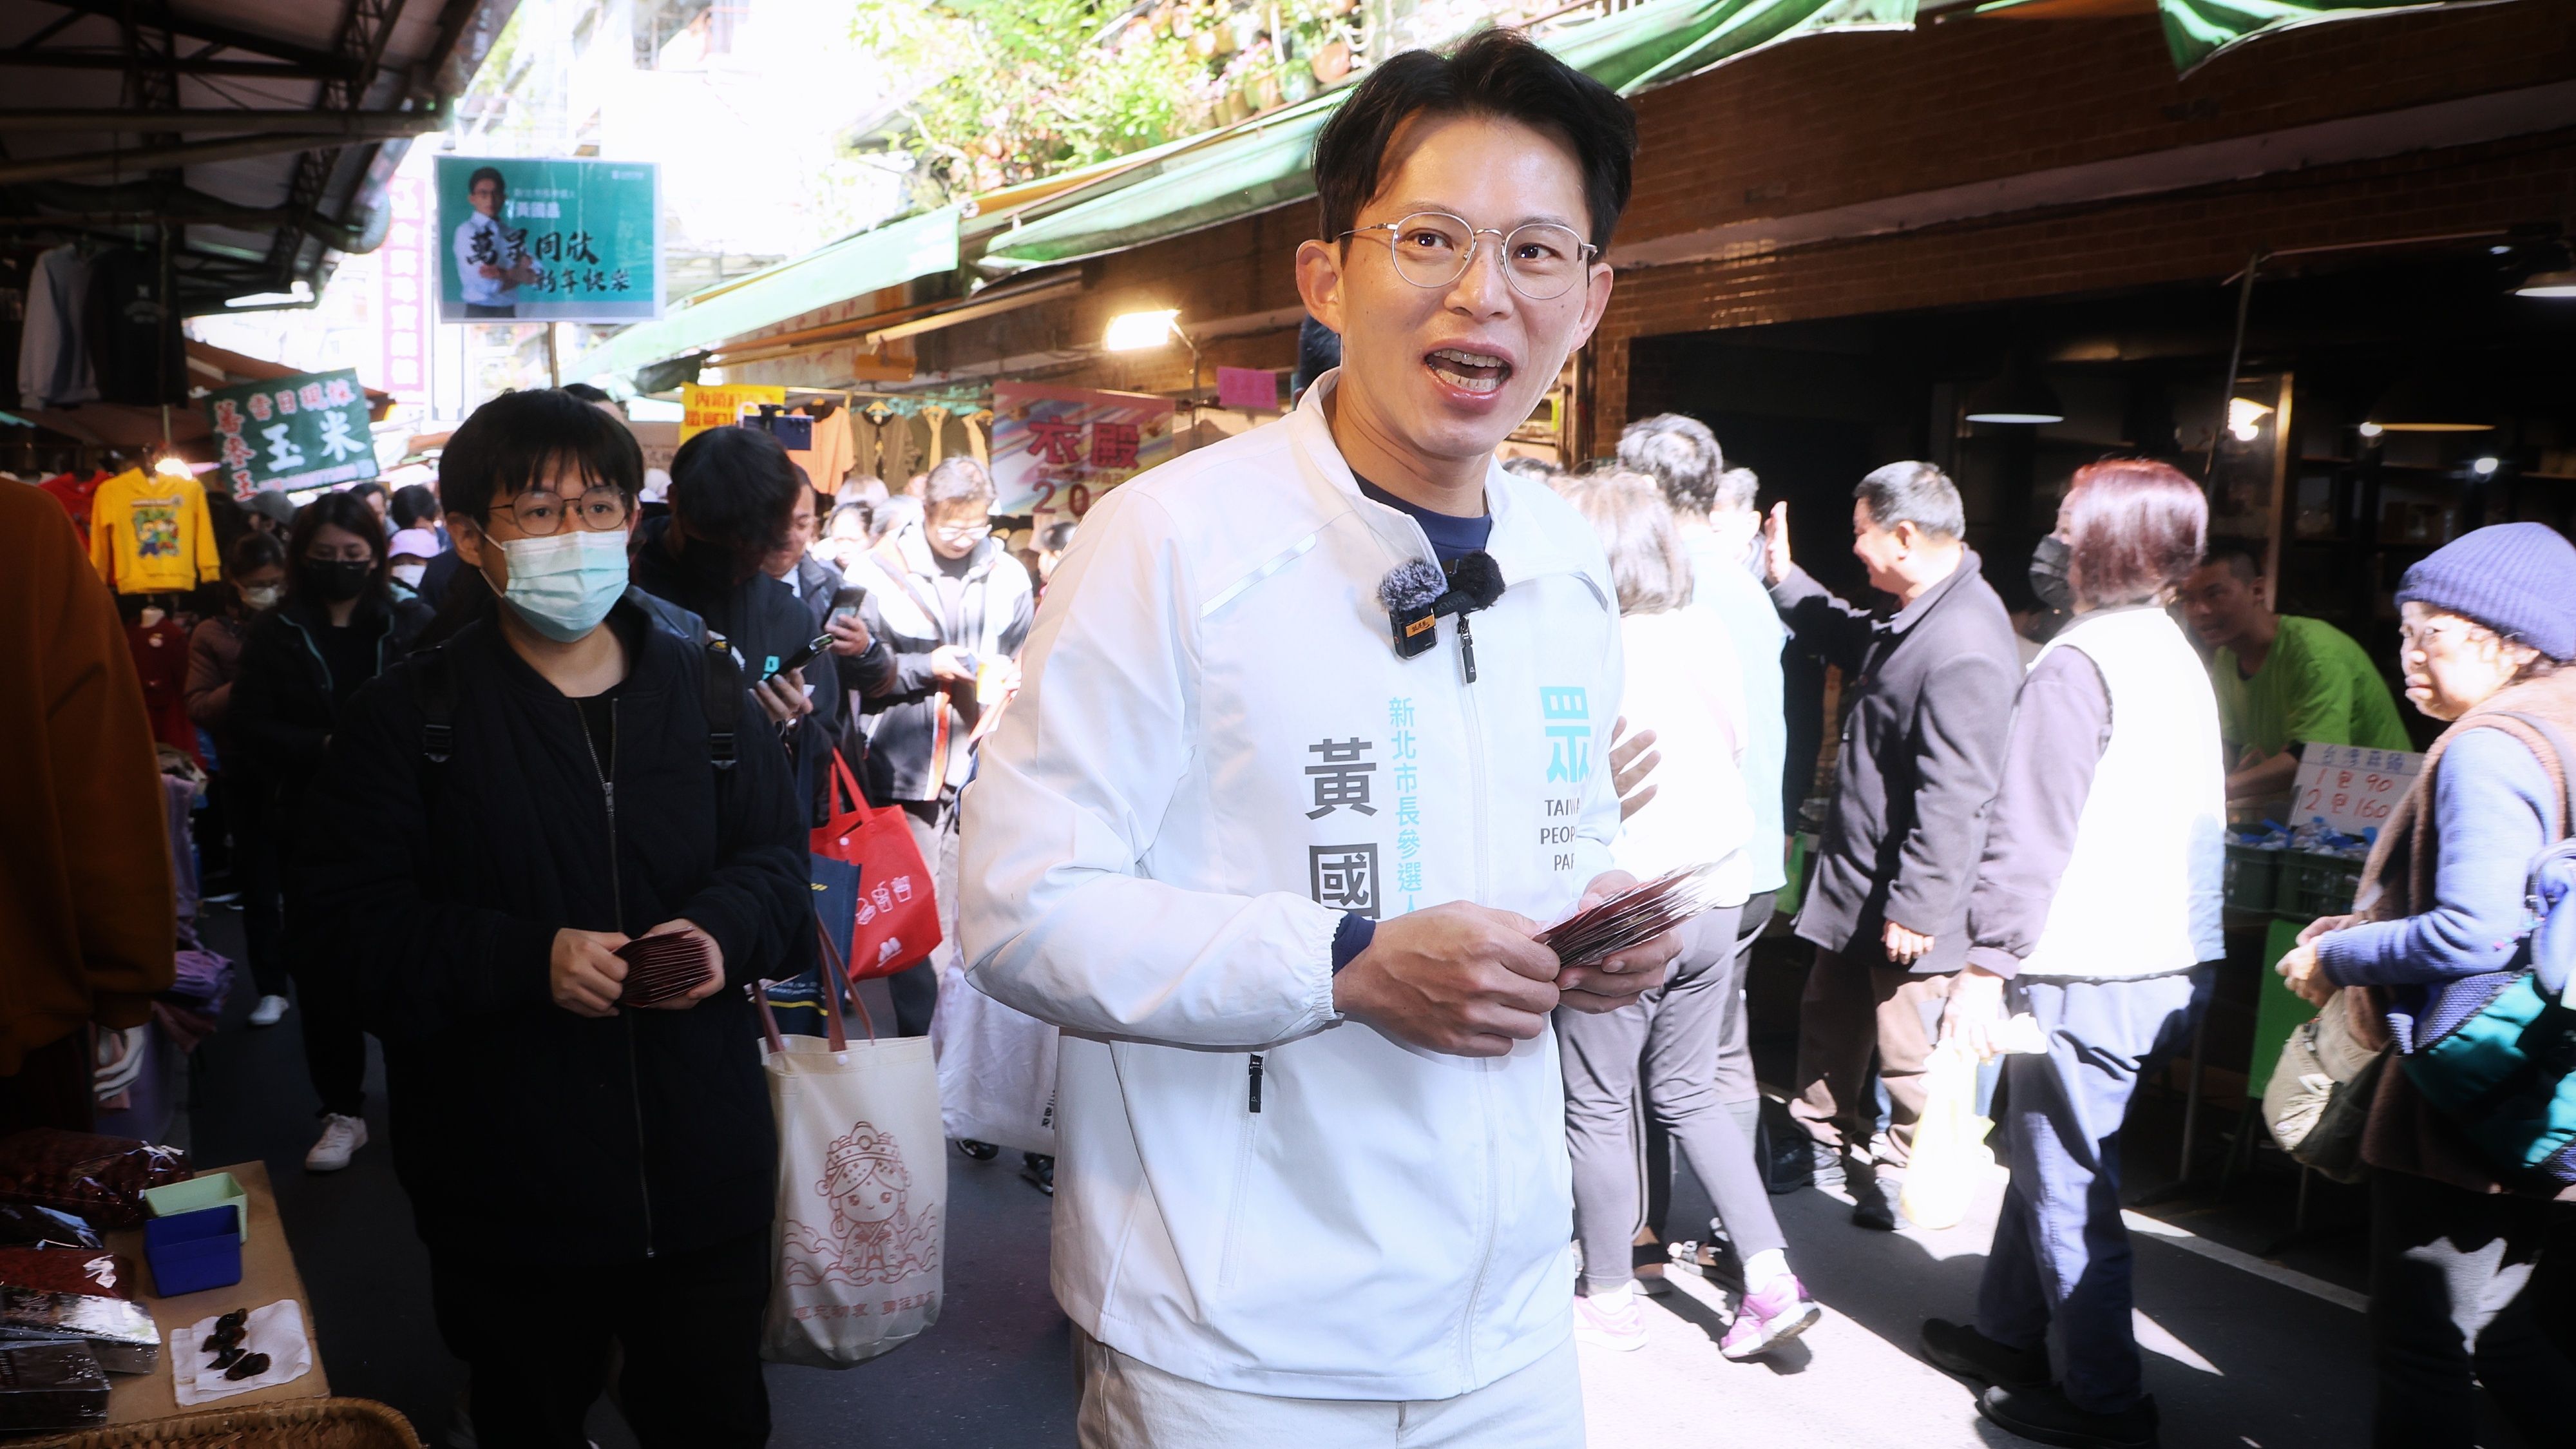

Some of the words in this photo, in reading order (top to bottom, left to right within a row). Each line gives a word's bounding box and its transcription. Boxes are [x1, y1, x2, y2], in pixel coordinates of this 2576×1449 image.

[262, 410, 366, 472] 玉米
[1028, 415, 1140, 469] 衣殿
[1304, 736, 1381, 919] 黃國
[1544, 798, 1579, 816] TAIWA
[1540, 825, 1576, 845] PEOP
